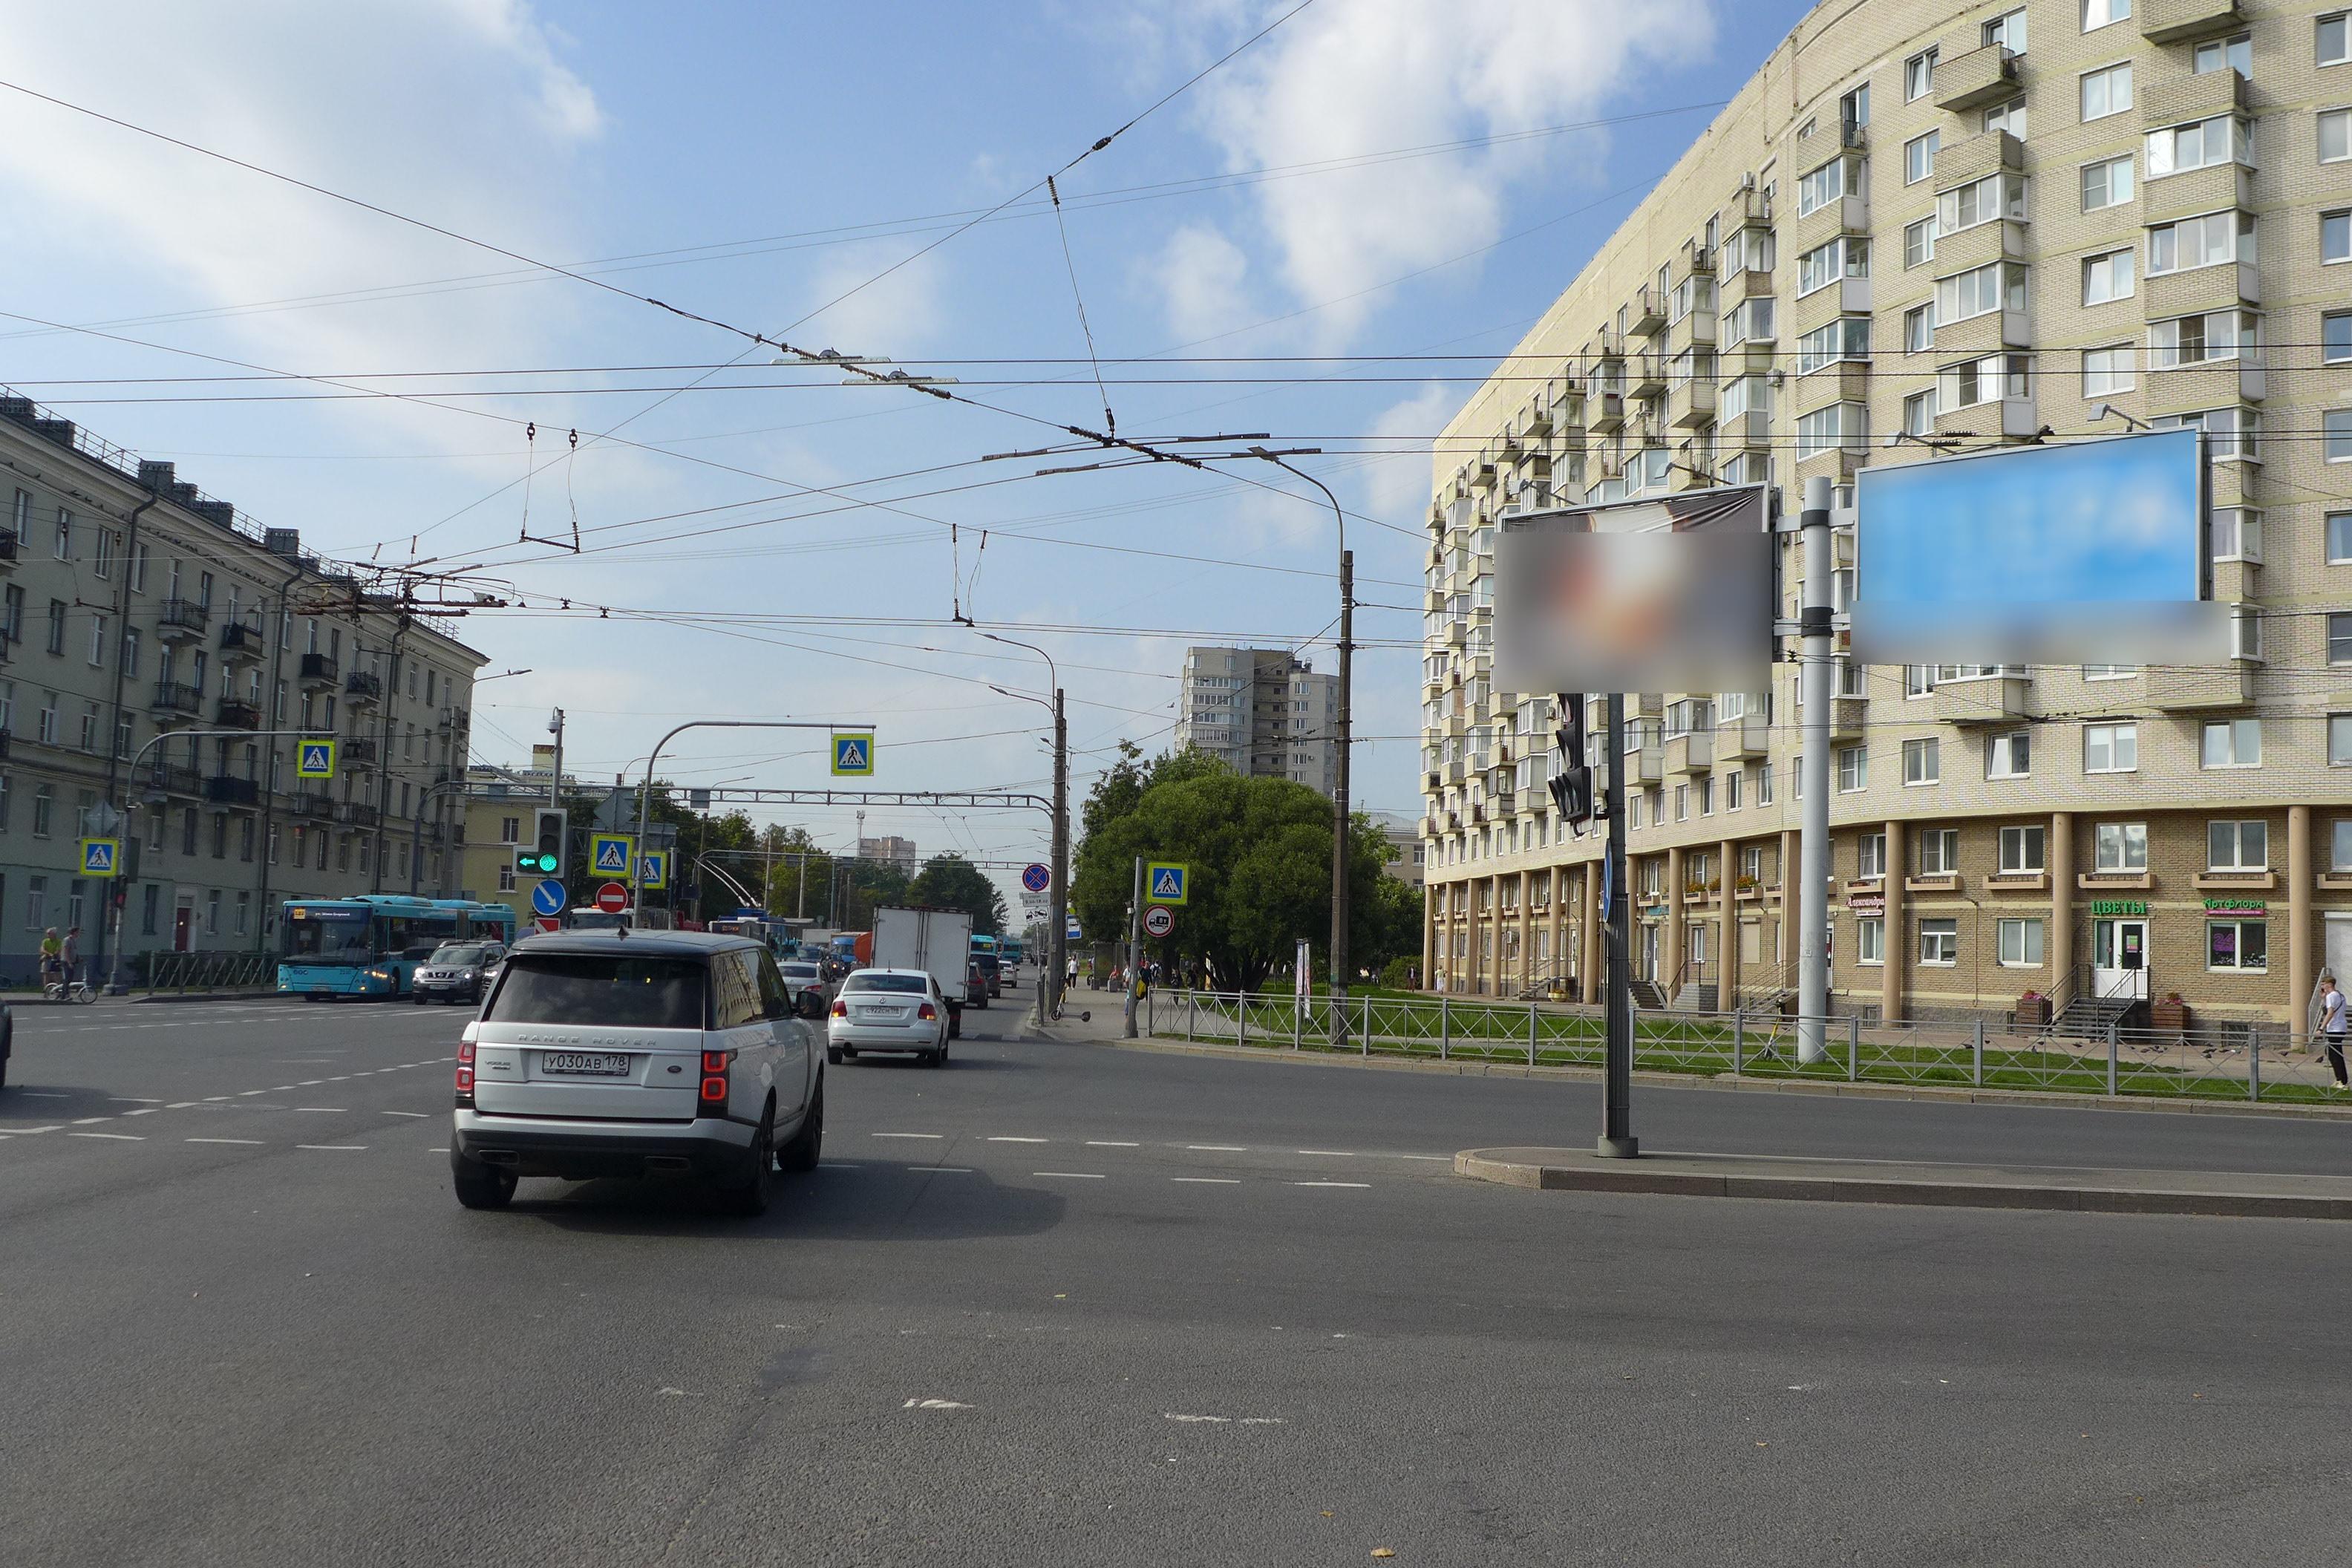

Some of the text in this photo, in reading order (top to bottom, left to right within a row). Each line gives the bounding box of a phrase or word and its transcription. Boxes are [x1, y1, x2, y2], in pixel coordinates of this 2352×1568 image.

[2091, 900, 2146, 915] ЦВЕТЫ
[2204, 898, 2264, 909] Артфлора
[518, 1033, 657, 1046] RANGE ROVER
[605, 1055, 625, 1066] 178
